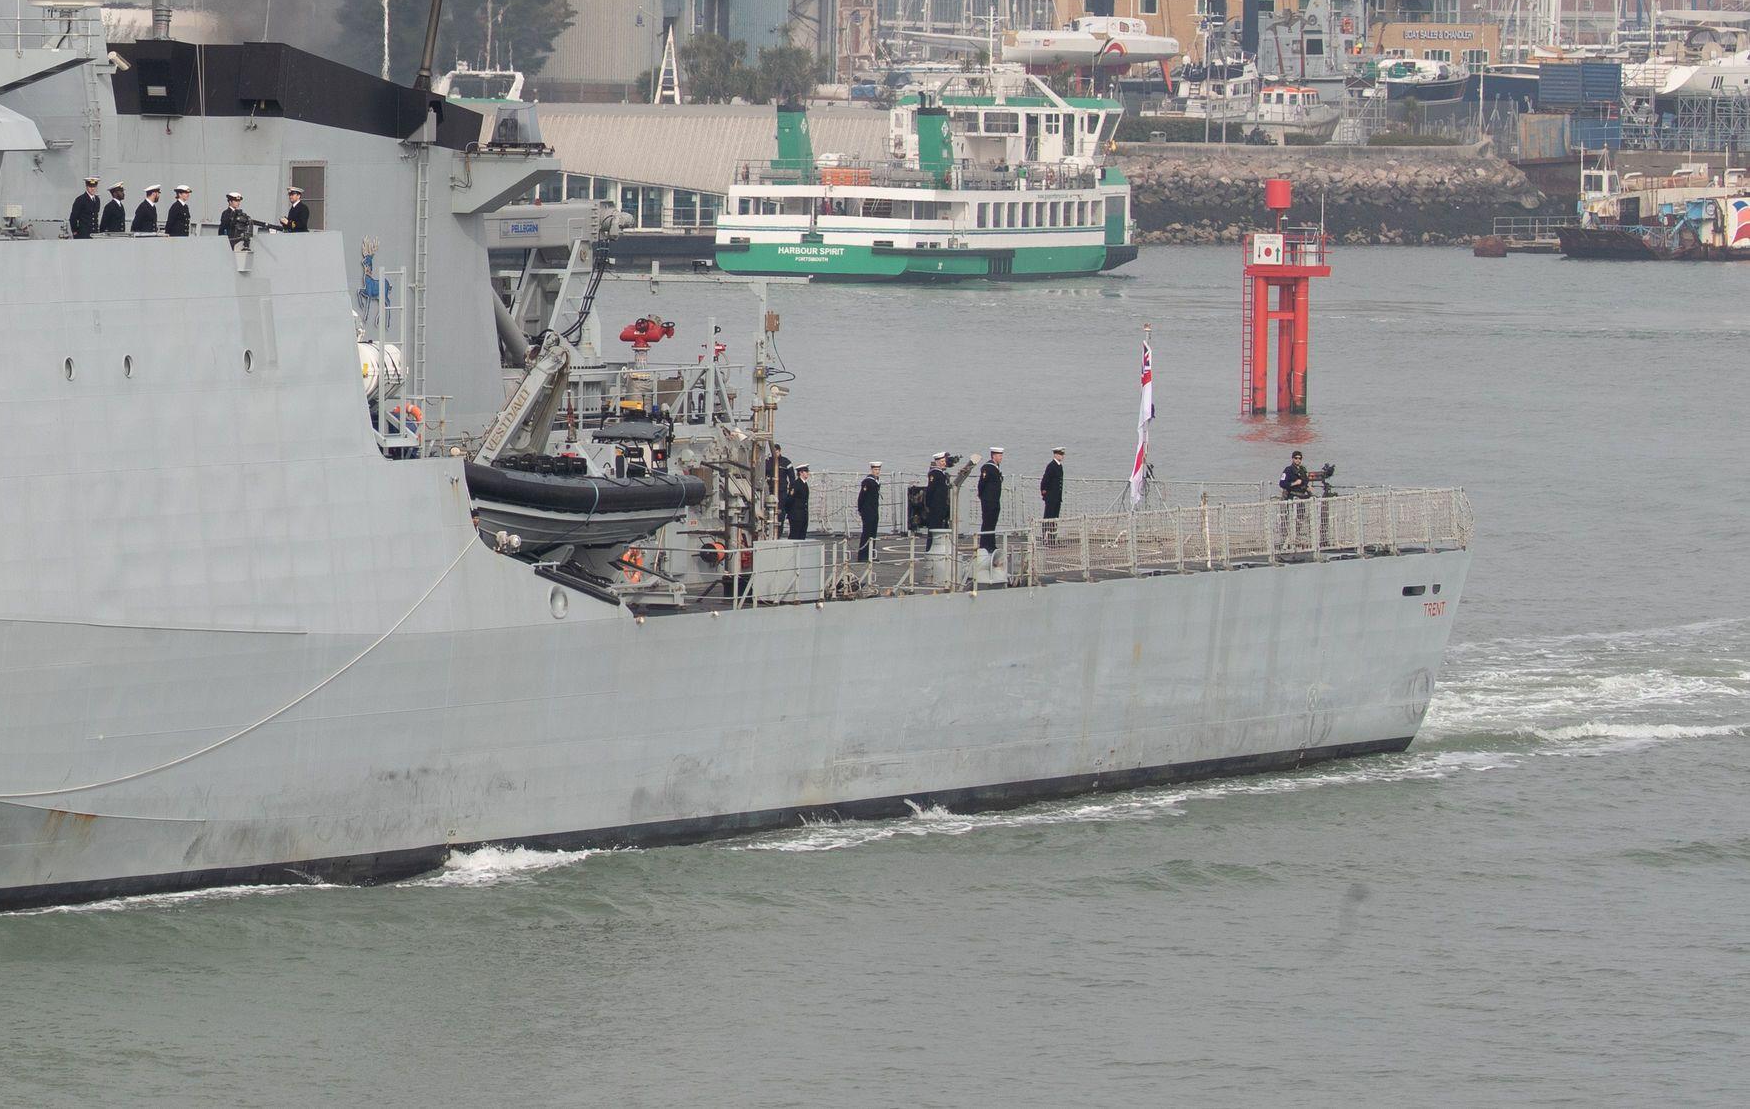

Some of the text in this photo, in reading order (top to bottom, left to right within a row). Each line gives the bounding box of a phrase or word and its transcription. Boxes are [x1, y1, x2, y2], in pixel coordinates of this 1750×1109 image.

[1403, 30, 1419, 40] BOAT
[1420, 30, 1438, 40] SALES
[777, 246, 845, 256] HARBOUR SPIRIT
[1423, 601, 1446, 618] TRENT
